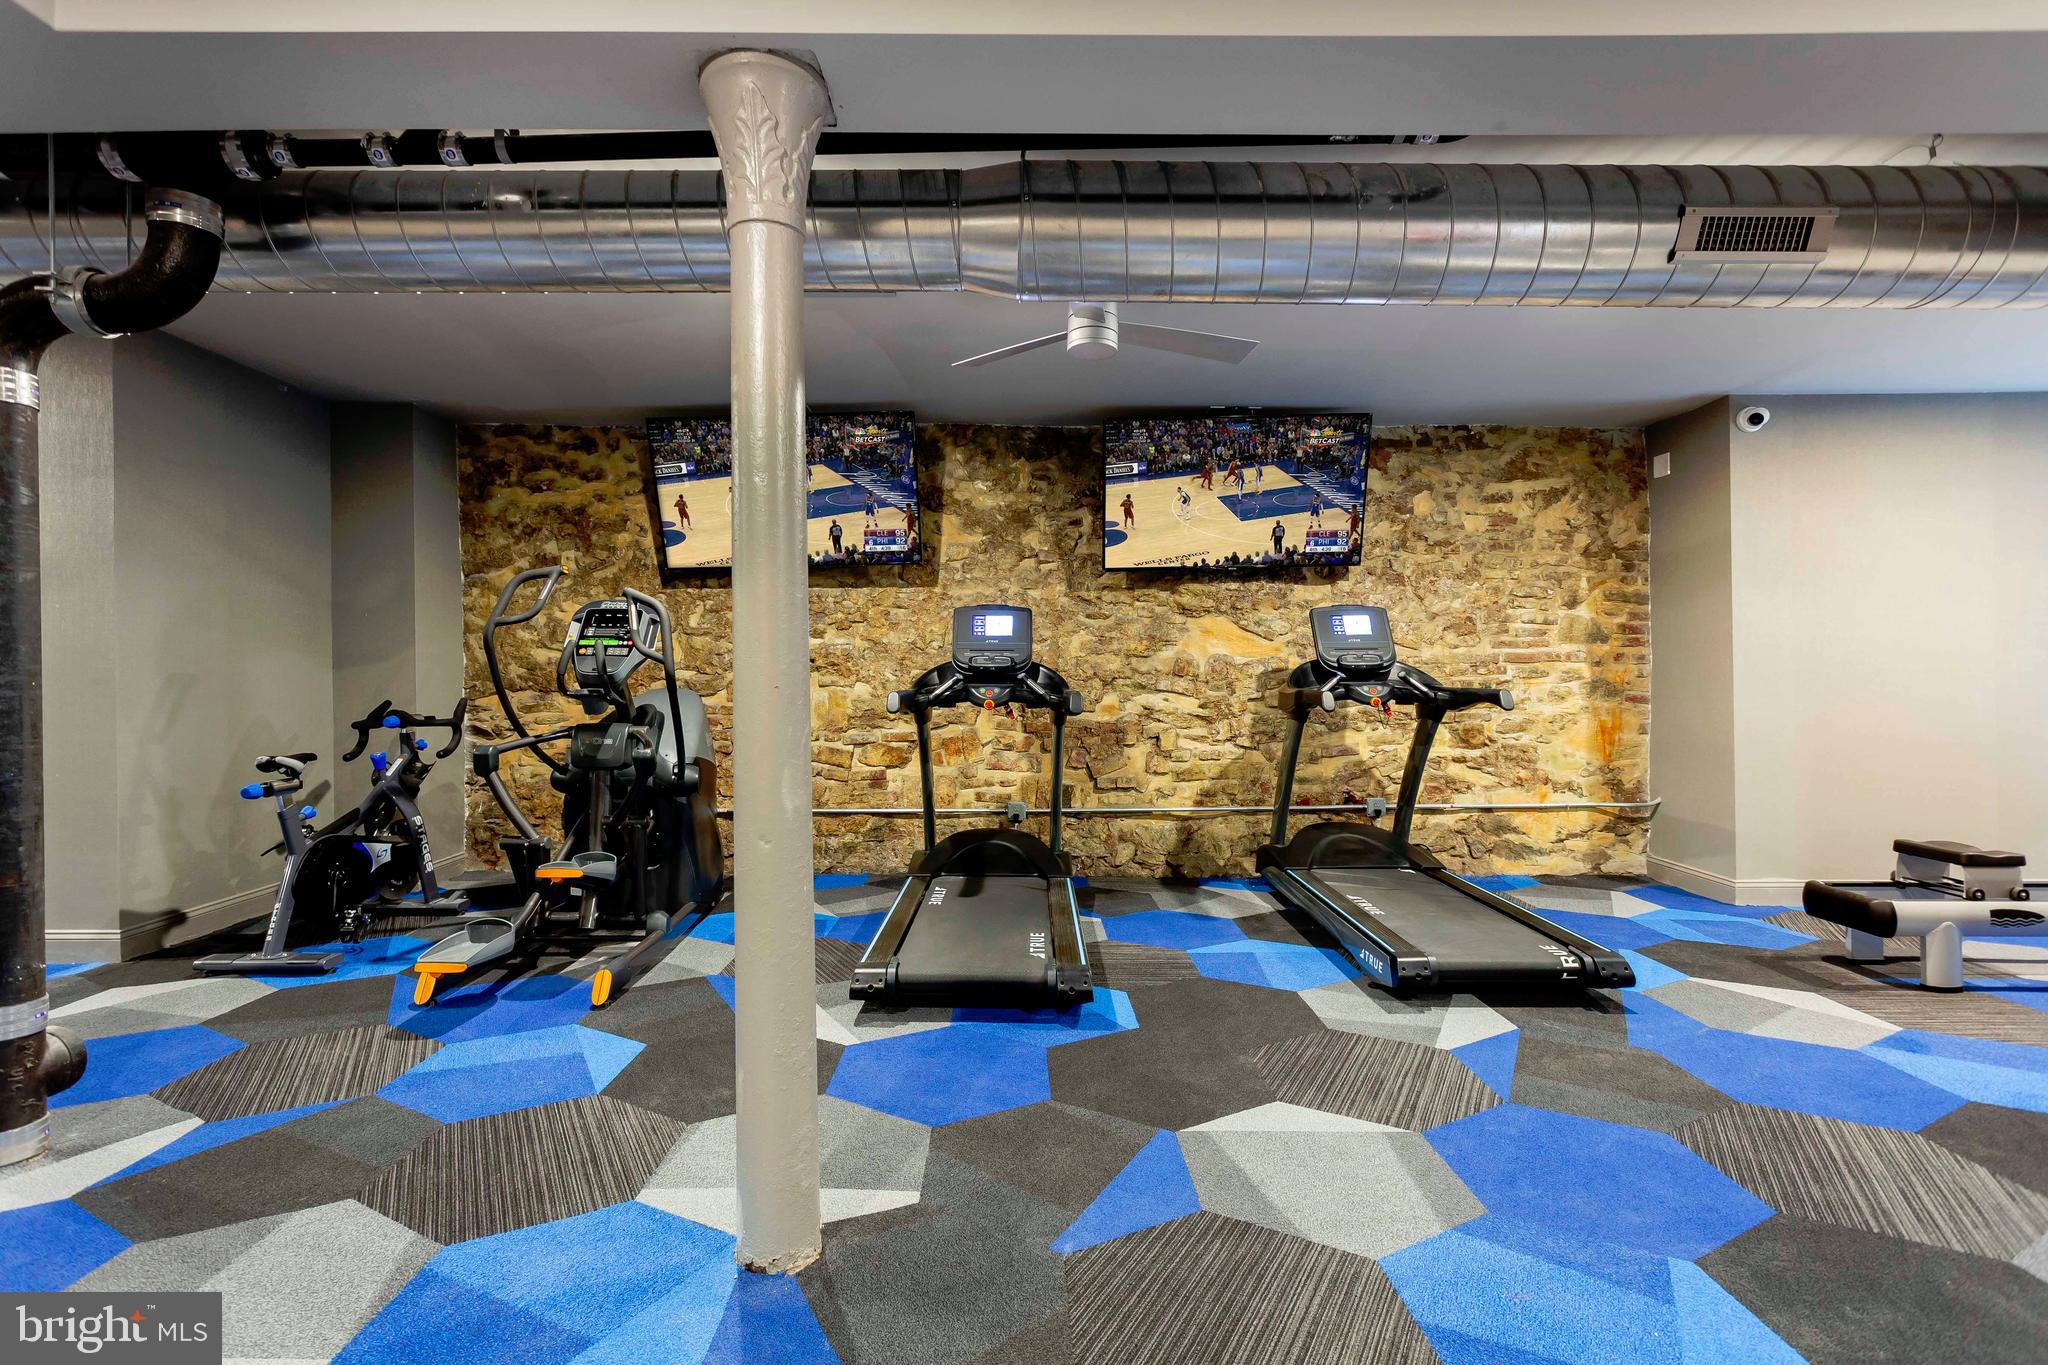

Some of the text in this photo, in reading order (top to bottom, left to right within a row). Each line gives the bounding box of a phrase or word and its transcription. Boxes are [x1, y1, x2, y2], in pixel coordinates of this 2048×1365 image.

[412, 815, 434, 873] STAGES
[929, 890, 946, 905] TRUE
[1030, 932, 1045, 952] TRUE
[1365, 950, 1383, 974] TRUE
